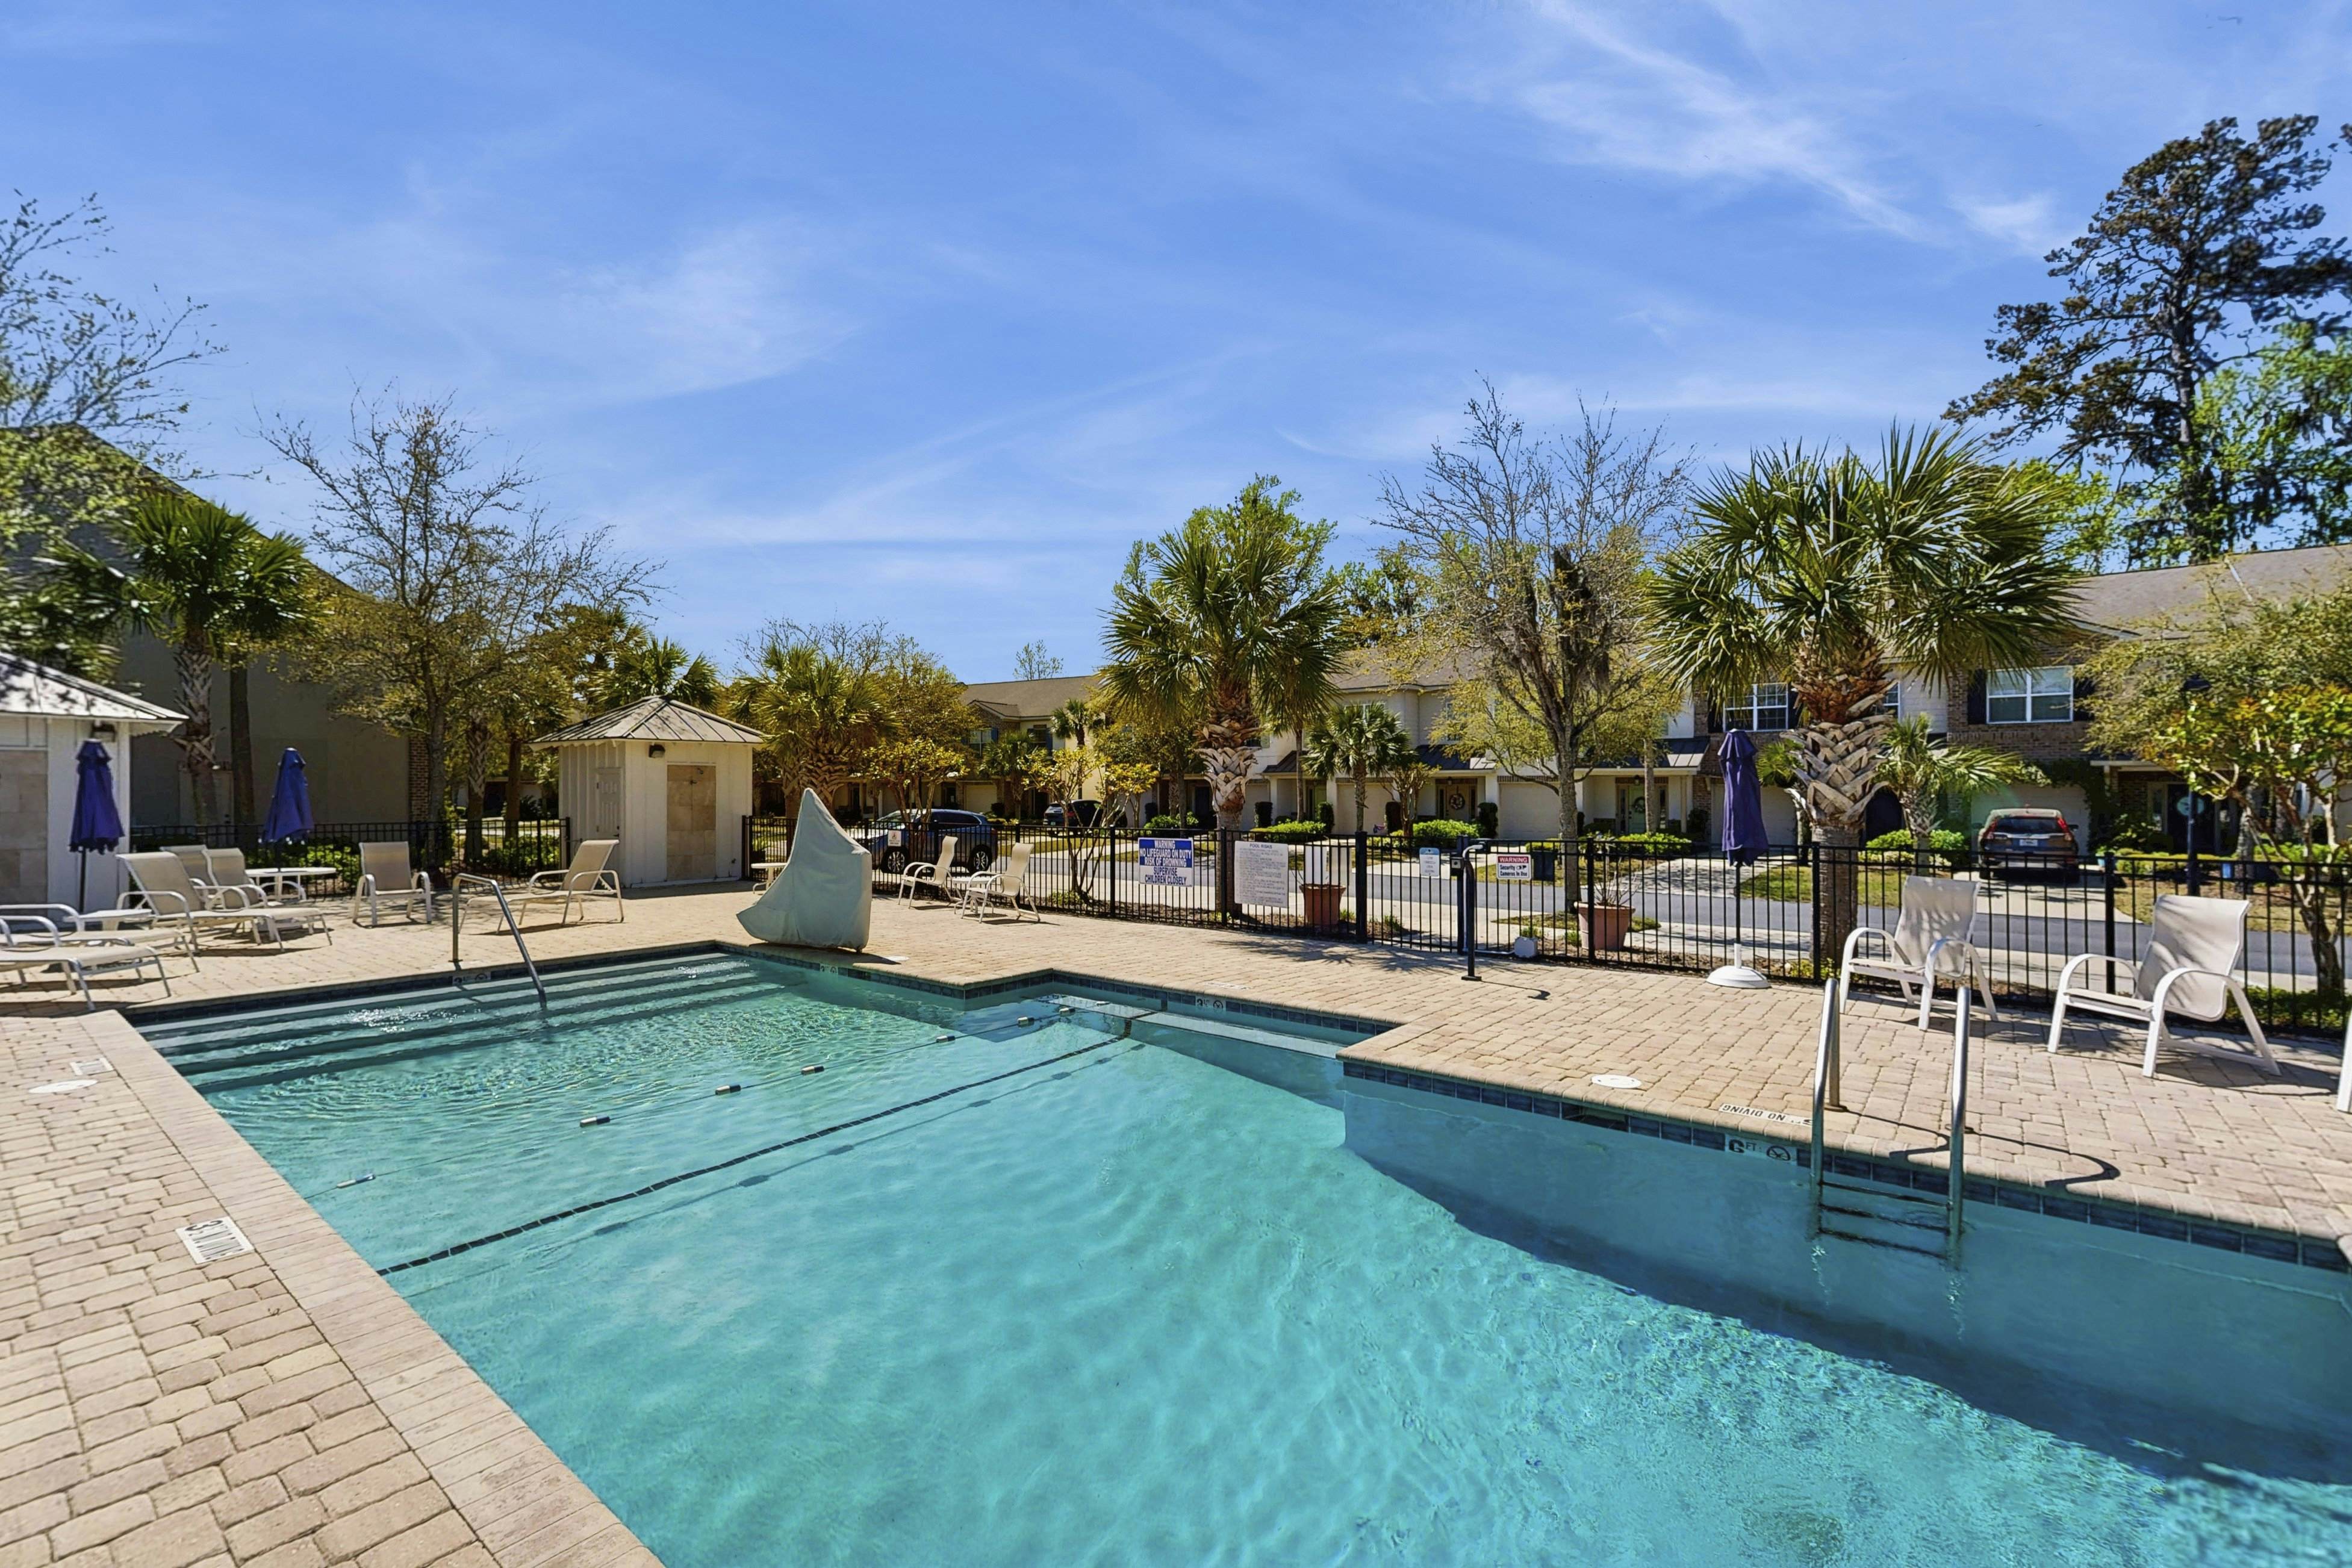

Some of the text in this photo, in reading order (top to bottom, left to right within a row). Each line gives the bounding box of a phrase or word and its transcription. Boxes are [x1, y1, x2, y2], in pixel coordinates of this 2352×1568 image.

[1154, 840, 1175, 849] WARNING
[1140, 848, 1192, 859] NO LIFEGUARD ON DUTY
[1145, 857, 1187, 867] RISK OF DROWNING
[1153, 866, 1177, 876] SUPERVISE
[1145, 874, 1187, 885] CHILDREN CLOSELY
[1722, 1104, 1785, 1121] NO DIVING
